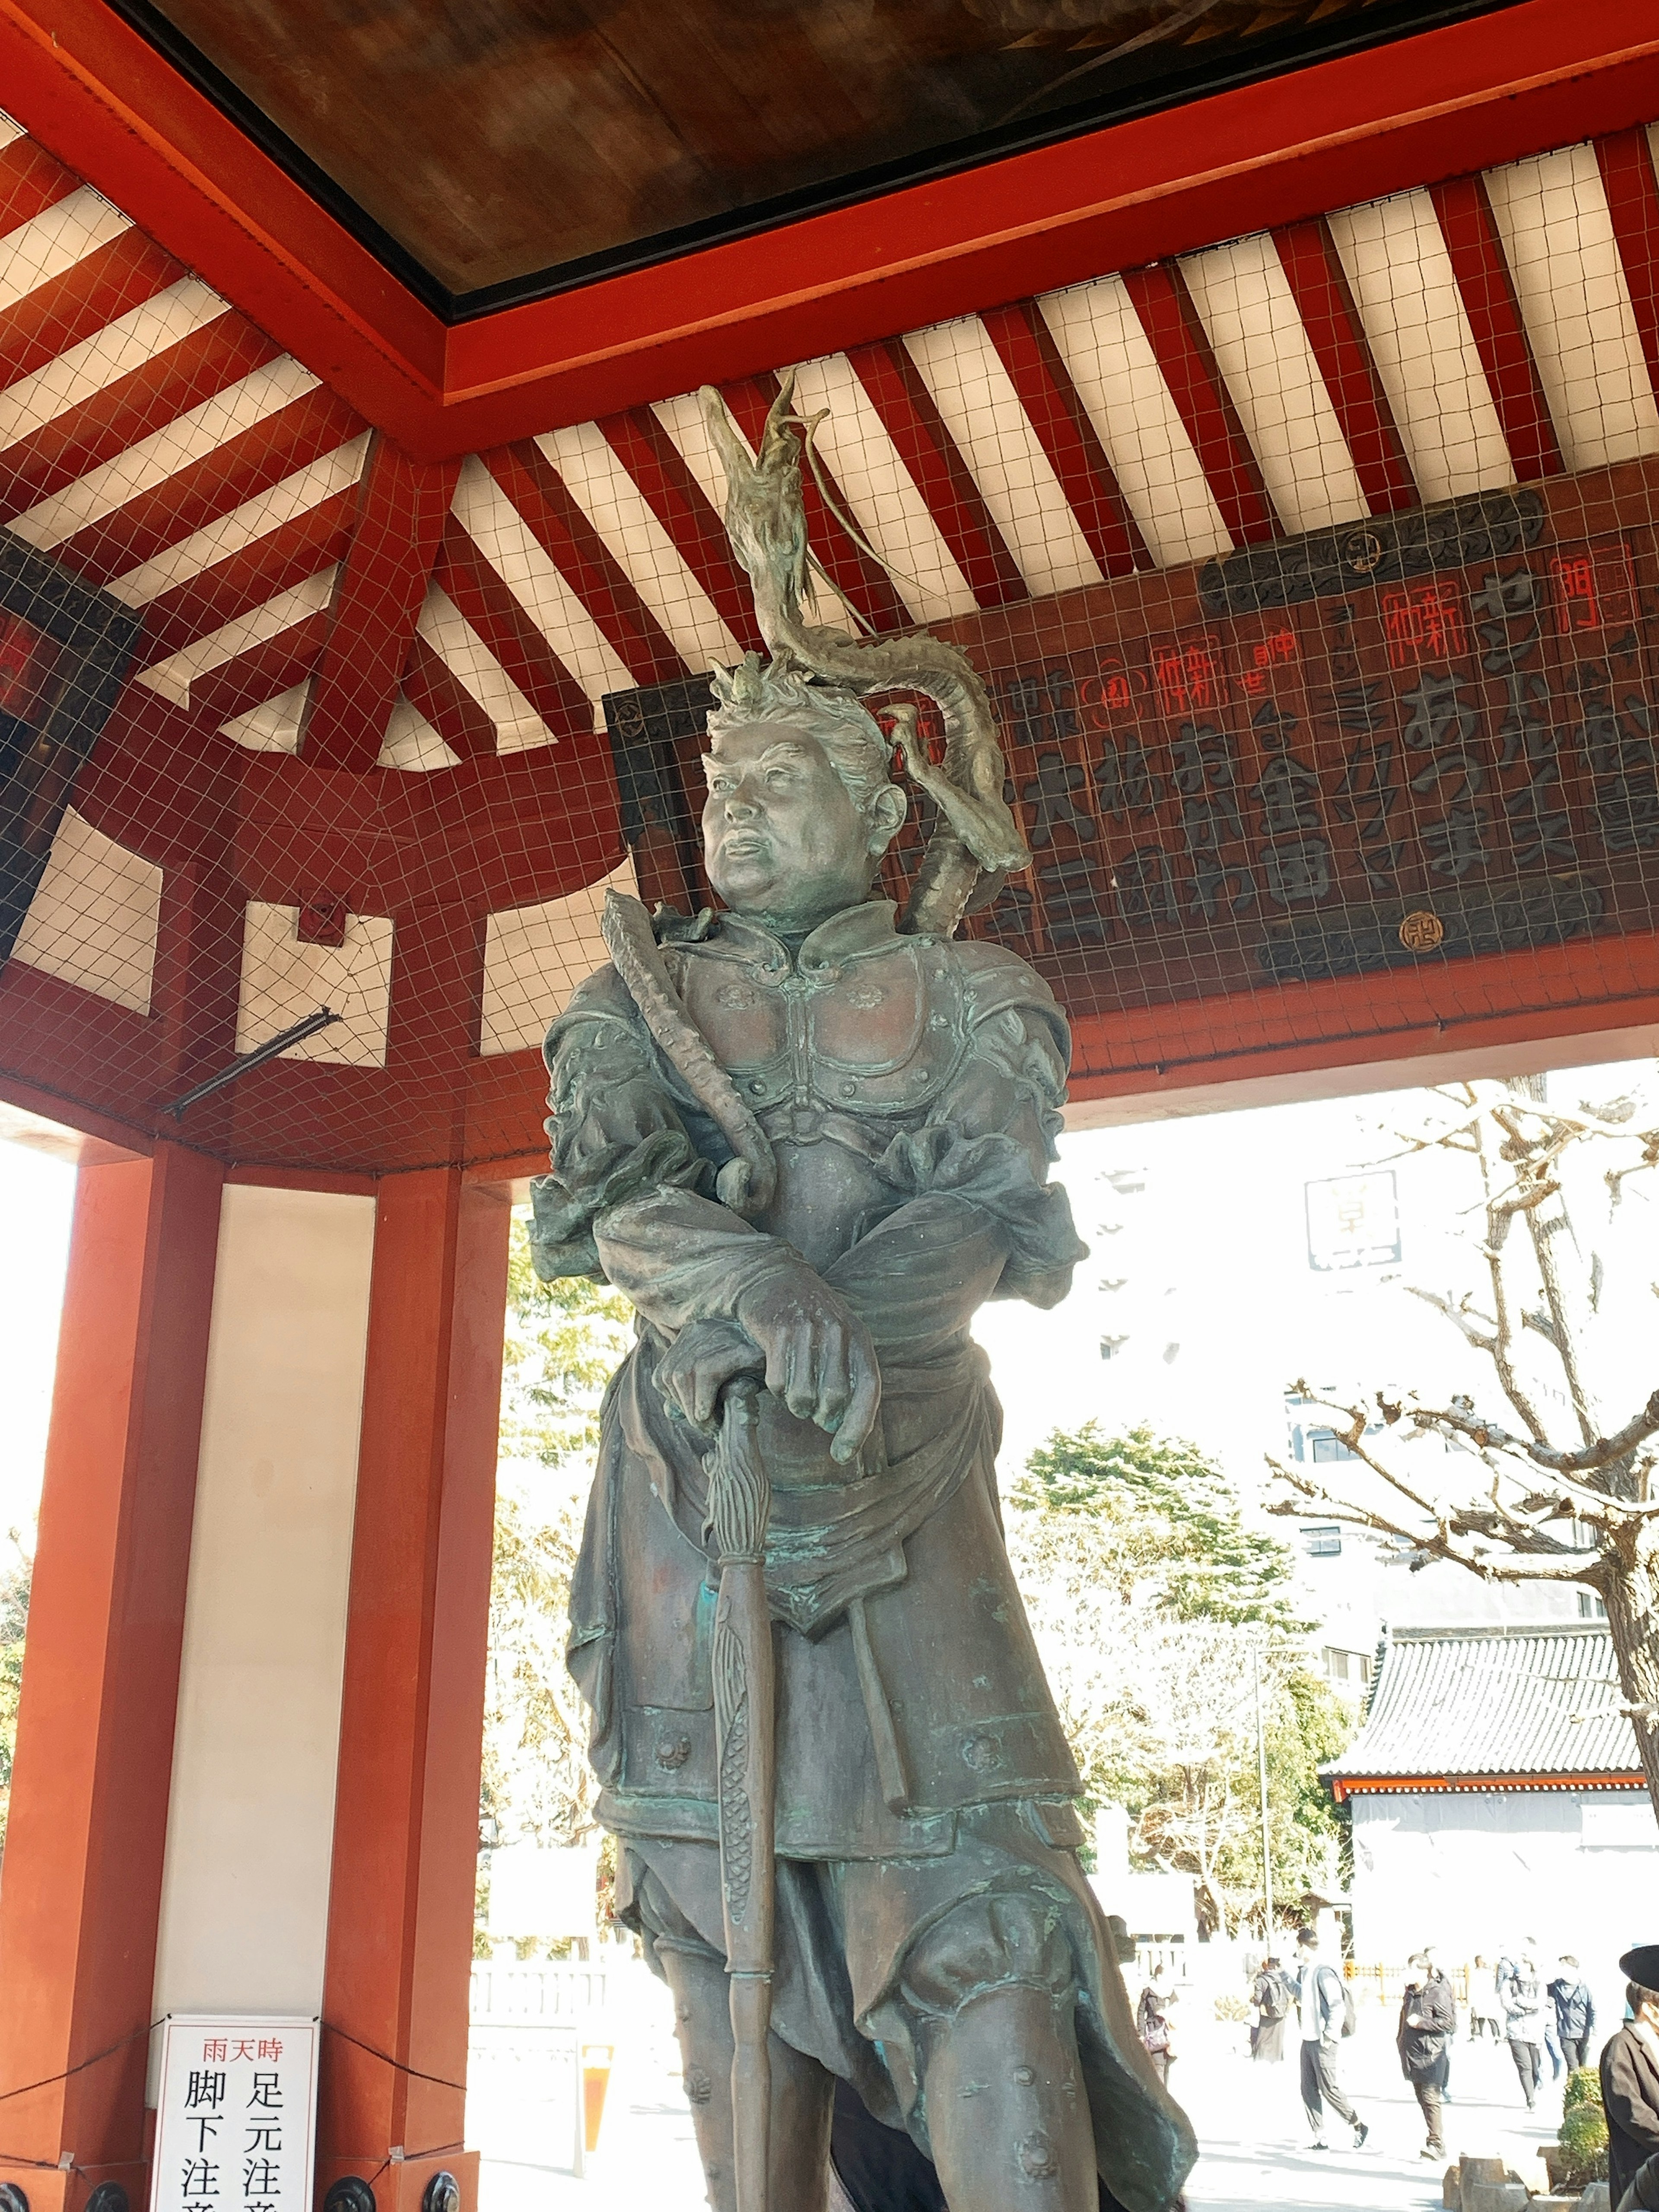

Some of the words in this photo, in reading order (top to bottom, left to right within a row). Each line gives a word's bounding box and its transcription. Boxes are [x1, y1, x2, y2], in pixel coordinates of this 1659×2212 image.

[1471, 565, 1578, 867] セントルイス
[1249, 755, 1329, 906] 金田
[203, 2037, 283, 2062] 雨天時
